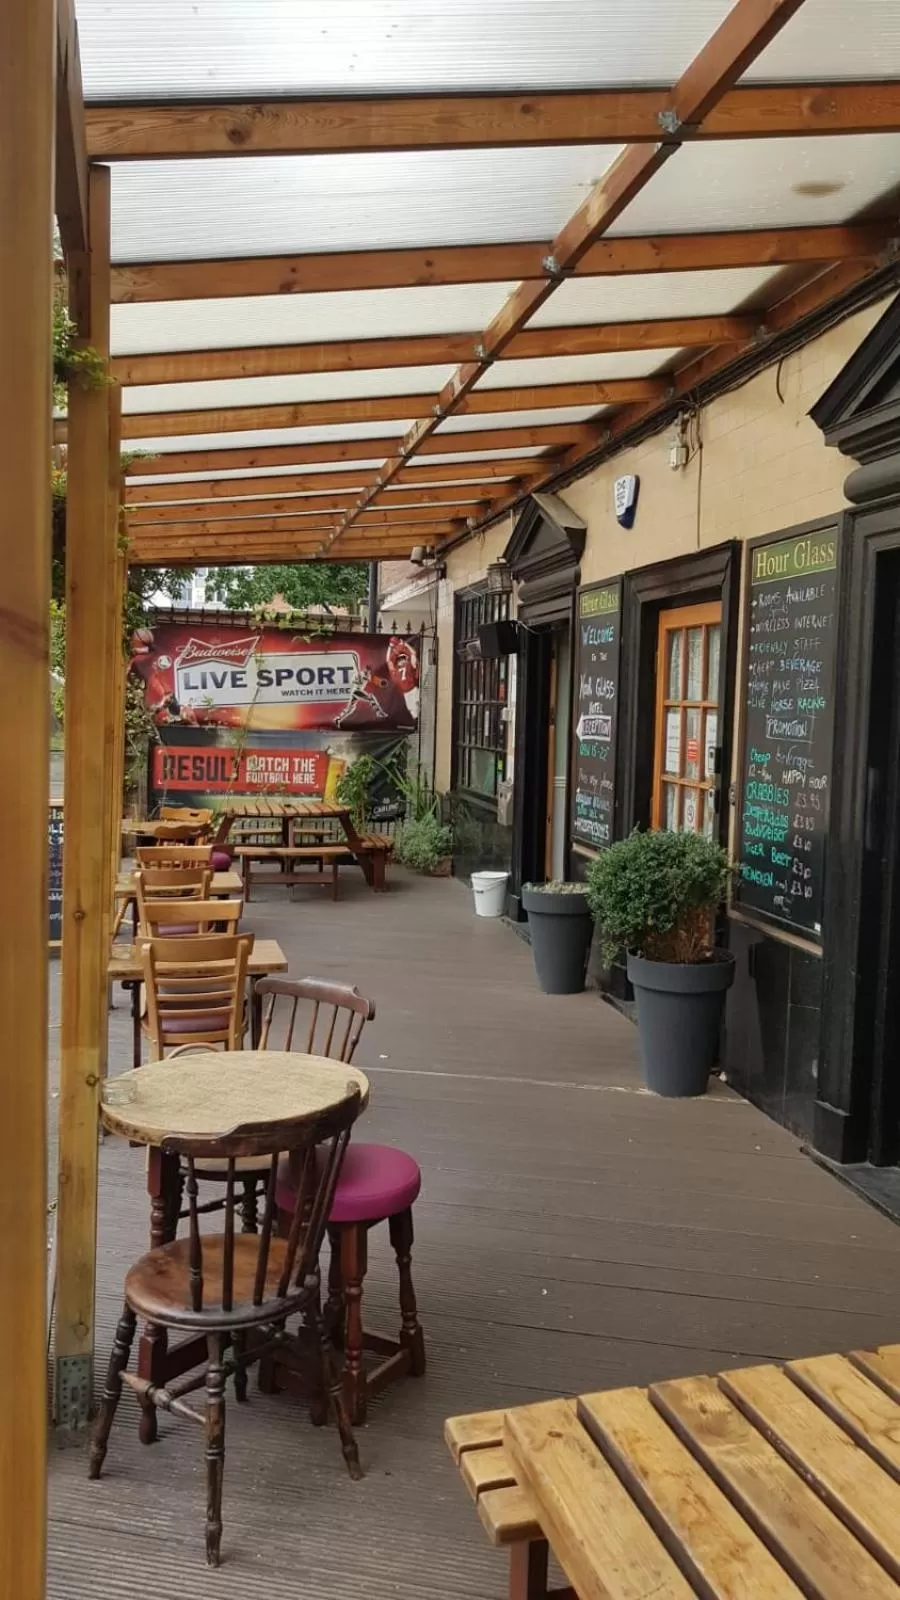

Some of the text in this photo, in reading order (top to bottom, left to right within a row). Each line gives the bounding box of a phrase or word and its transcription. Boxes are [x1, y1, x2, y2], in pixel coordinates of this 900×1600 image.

[755, 540, 835, 578] Hour Glass
[582, 590, 619, 614] Hour Glass
[786, 584, 825, 605] AVAILABLE
[795, 614, 834, 629] INTERNET
[581, 624, 615, 646] WELCOME
[793, 637, 822, 651] STAFF
[176, 642, 256, 661] Budweiser
[399, 668, 406, 681] 7
[780, 658, 823, 673] BEVERAGE
[183, 666, 354, 691] LIVE SPORT
[596, 677, 615, 699] GLASS
[326, 688, 351, 696] HERE
[798, 697, 826, 711] RACING
[768, 719, 807, 738] PROMOTION
[163, 754, 242, 782] RESULT
[246, 755, 316, 772] WATCH THE
[246, 772, 316, 785] FOOTBALL HERE
[782, 769, 807, 788] HAPPY
[746, 780, 789, 807] CRABBIES
